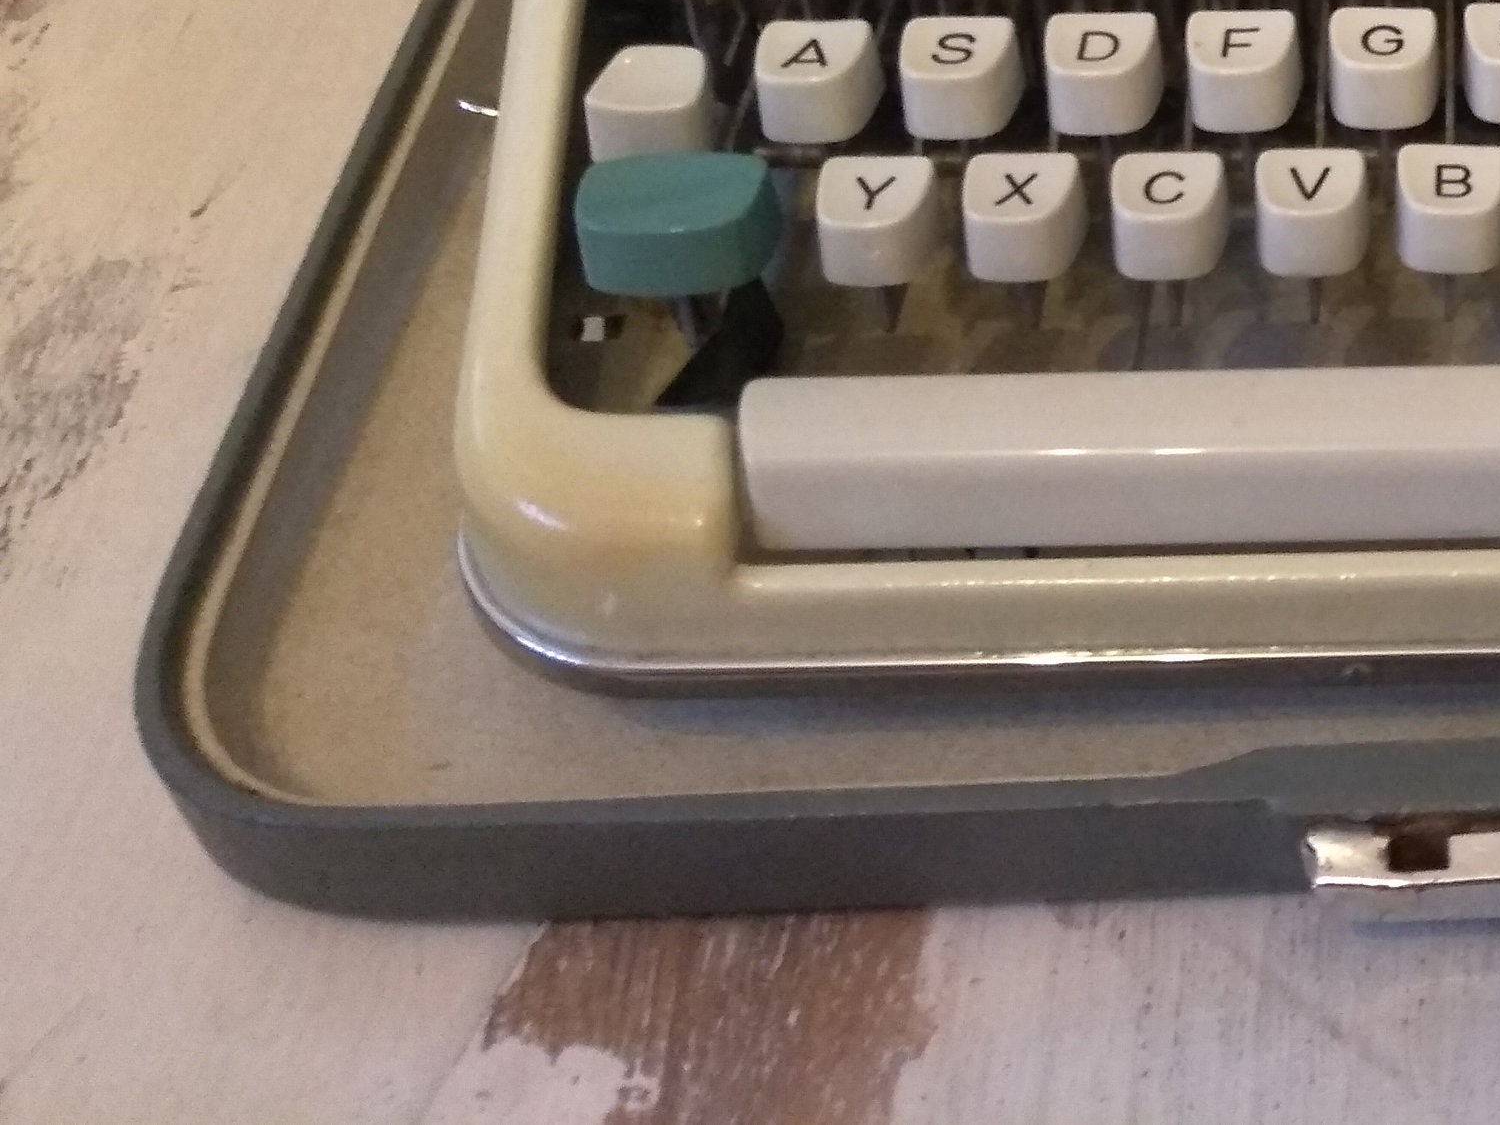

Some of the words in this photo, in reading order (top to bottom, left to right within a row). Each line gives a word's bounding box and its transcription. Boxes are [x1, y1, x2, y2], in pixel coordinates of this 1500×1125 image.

[780, 38, 828, 69] A
[930, 32, 977, 65] S
[1076, 30, 1121, 62] D
[1220, 27, 1260, 58] F
[1360, 24, 1405, 56] G
[856, 176, 896, 211] Y
[994, 173, 1038, 206] X
[1143, 171, 1186, 205] C
[1289, 166, 1331, 202] V
[1434, 163, 1473, 199] B
